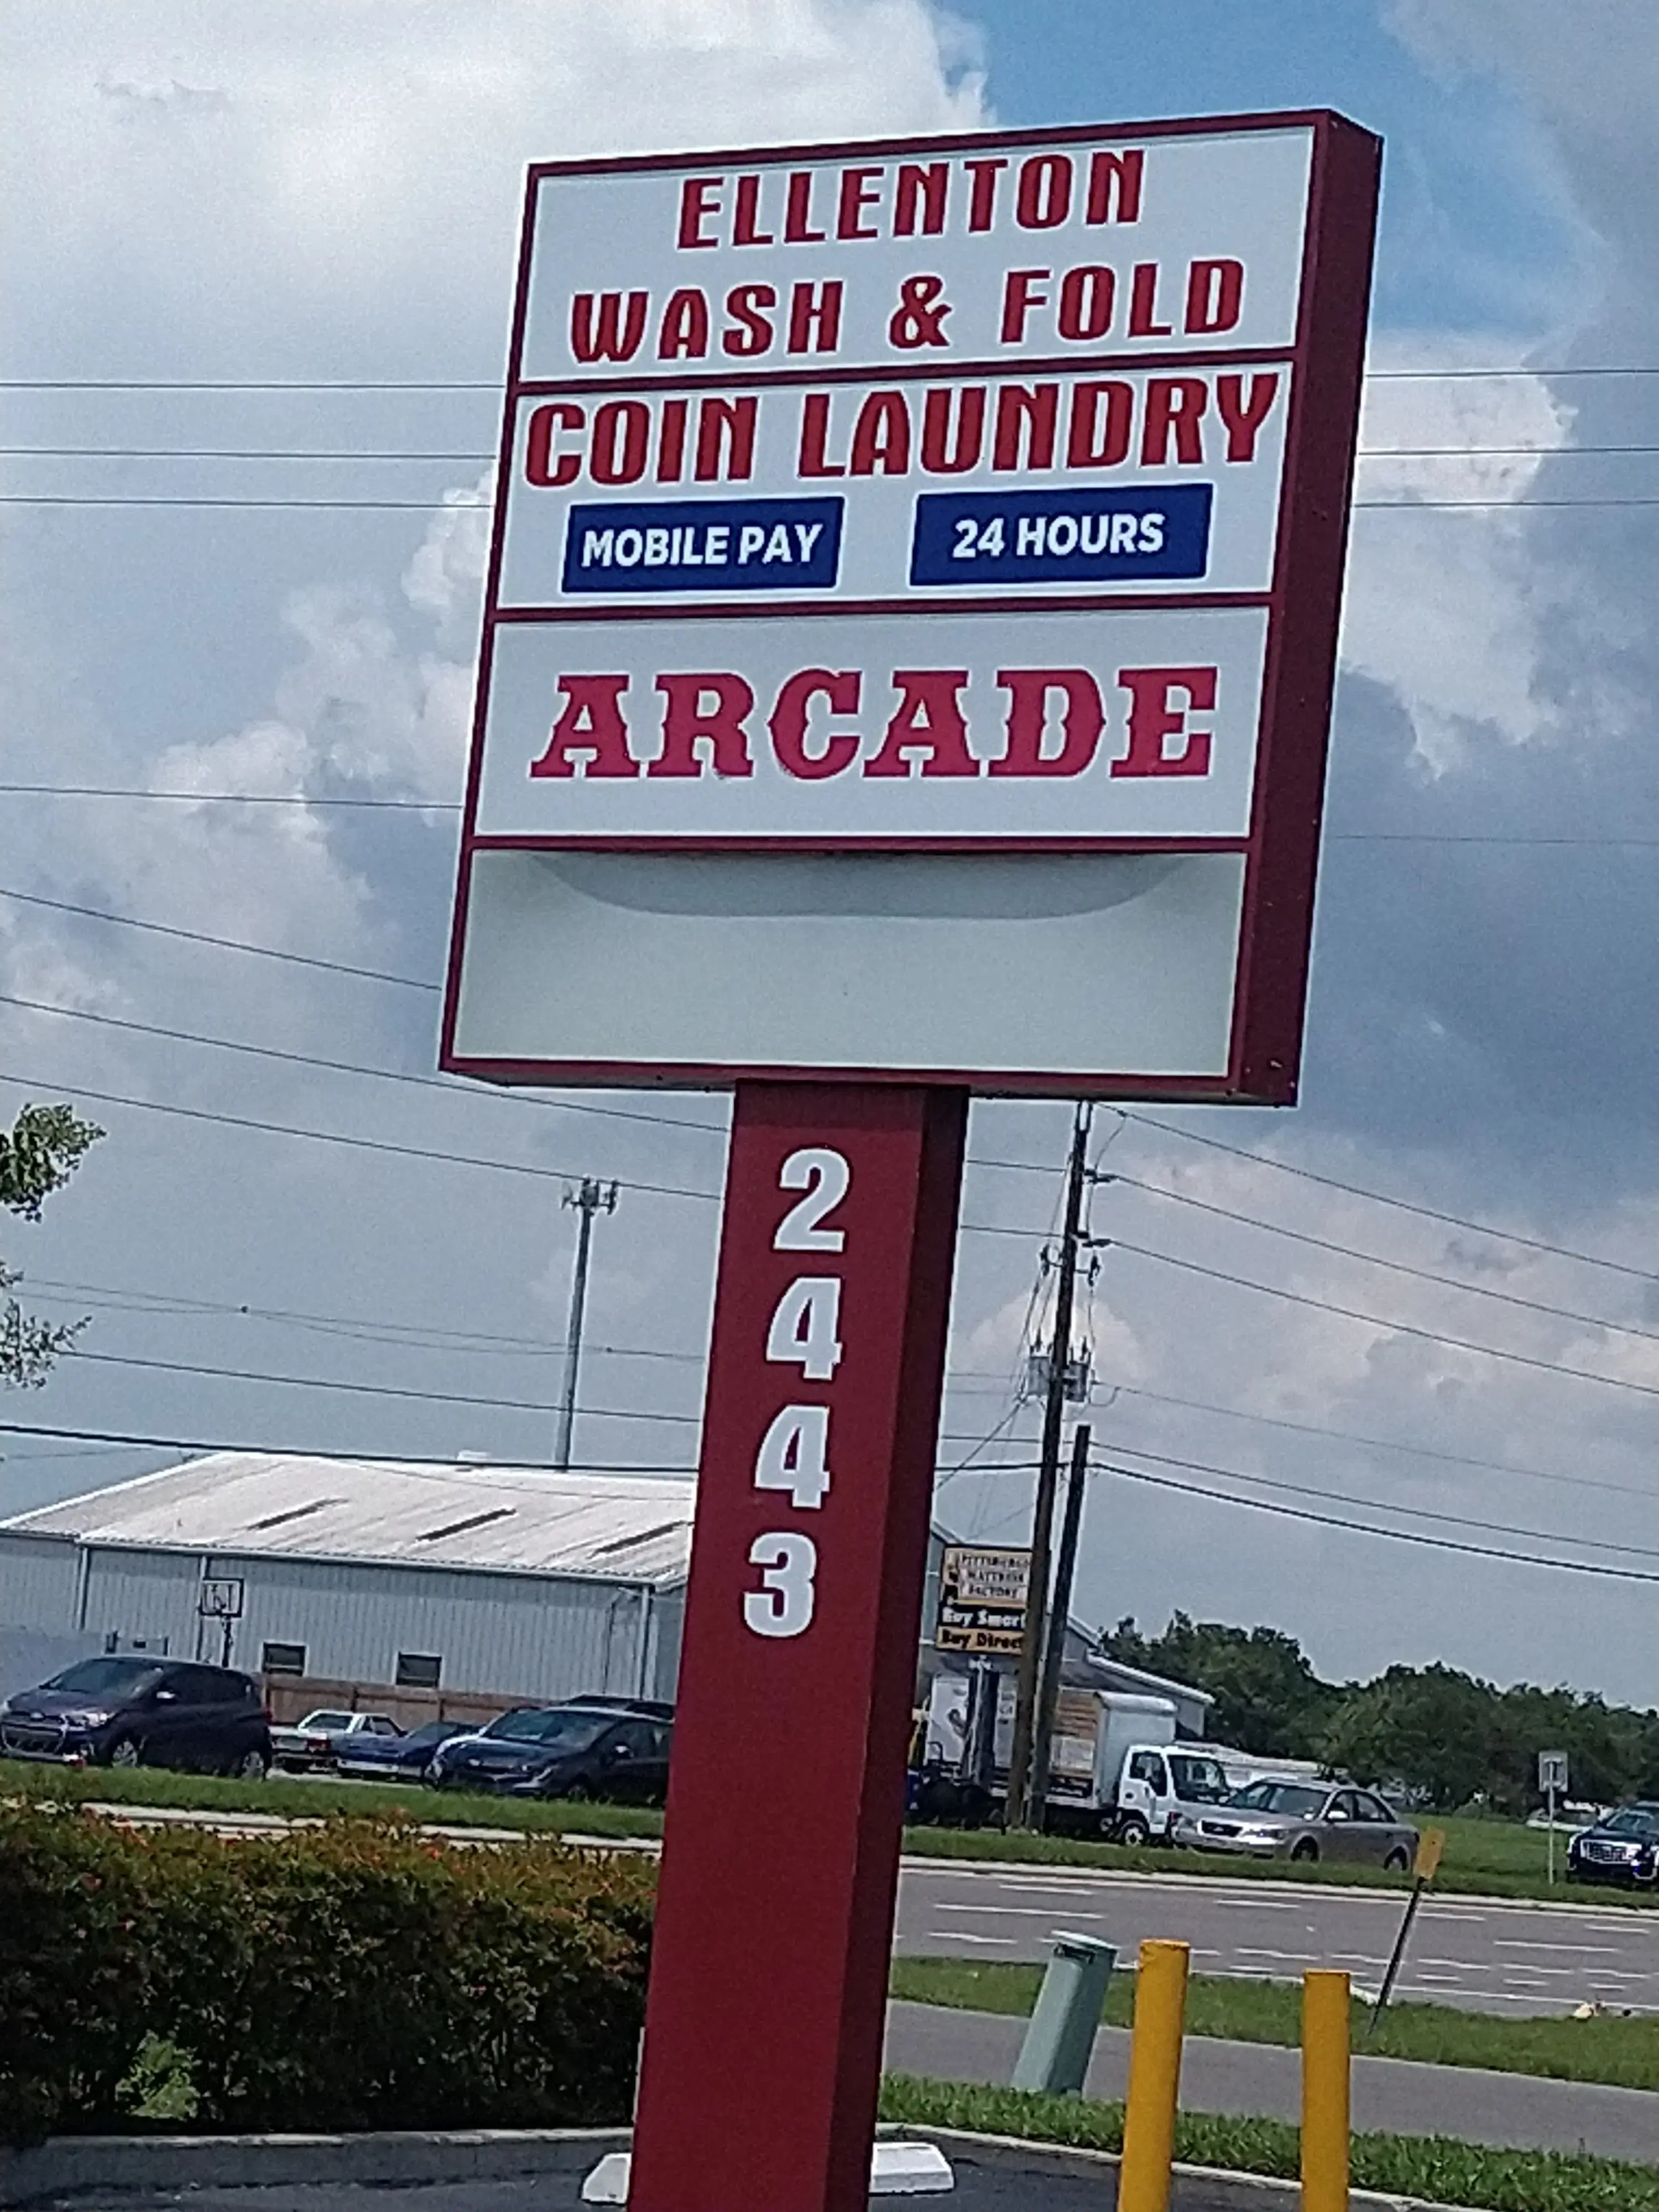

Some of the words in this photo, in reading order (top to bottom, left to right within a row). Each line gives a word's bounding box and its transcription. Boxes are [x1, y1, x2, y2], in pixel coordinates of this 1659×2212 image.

[678, 149, 1144, 249] ELLENTON
[571, 281, 843, 363] WASH
[889, 276, 951, 349] &
[1001, 259, 1244, 344] FOLD
[526, 397, 758, 488] COIN
[797, 373, 1279, 478] LAUNDRY
[581, 527, 731, 567] MOBILE
[738, 523, 823, 565] PAY
[952, 517, 1005, 559] 24
[1016, 513, 1166, 556] HOURS
[529, 666, 1218, 780] ARCADE
